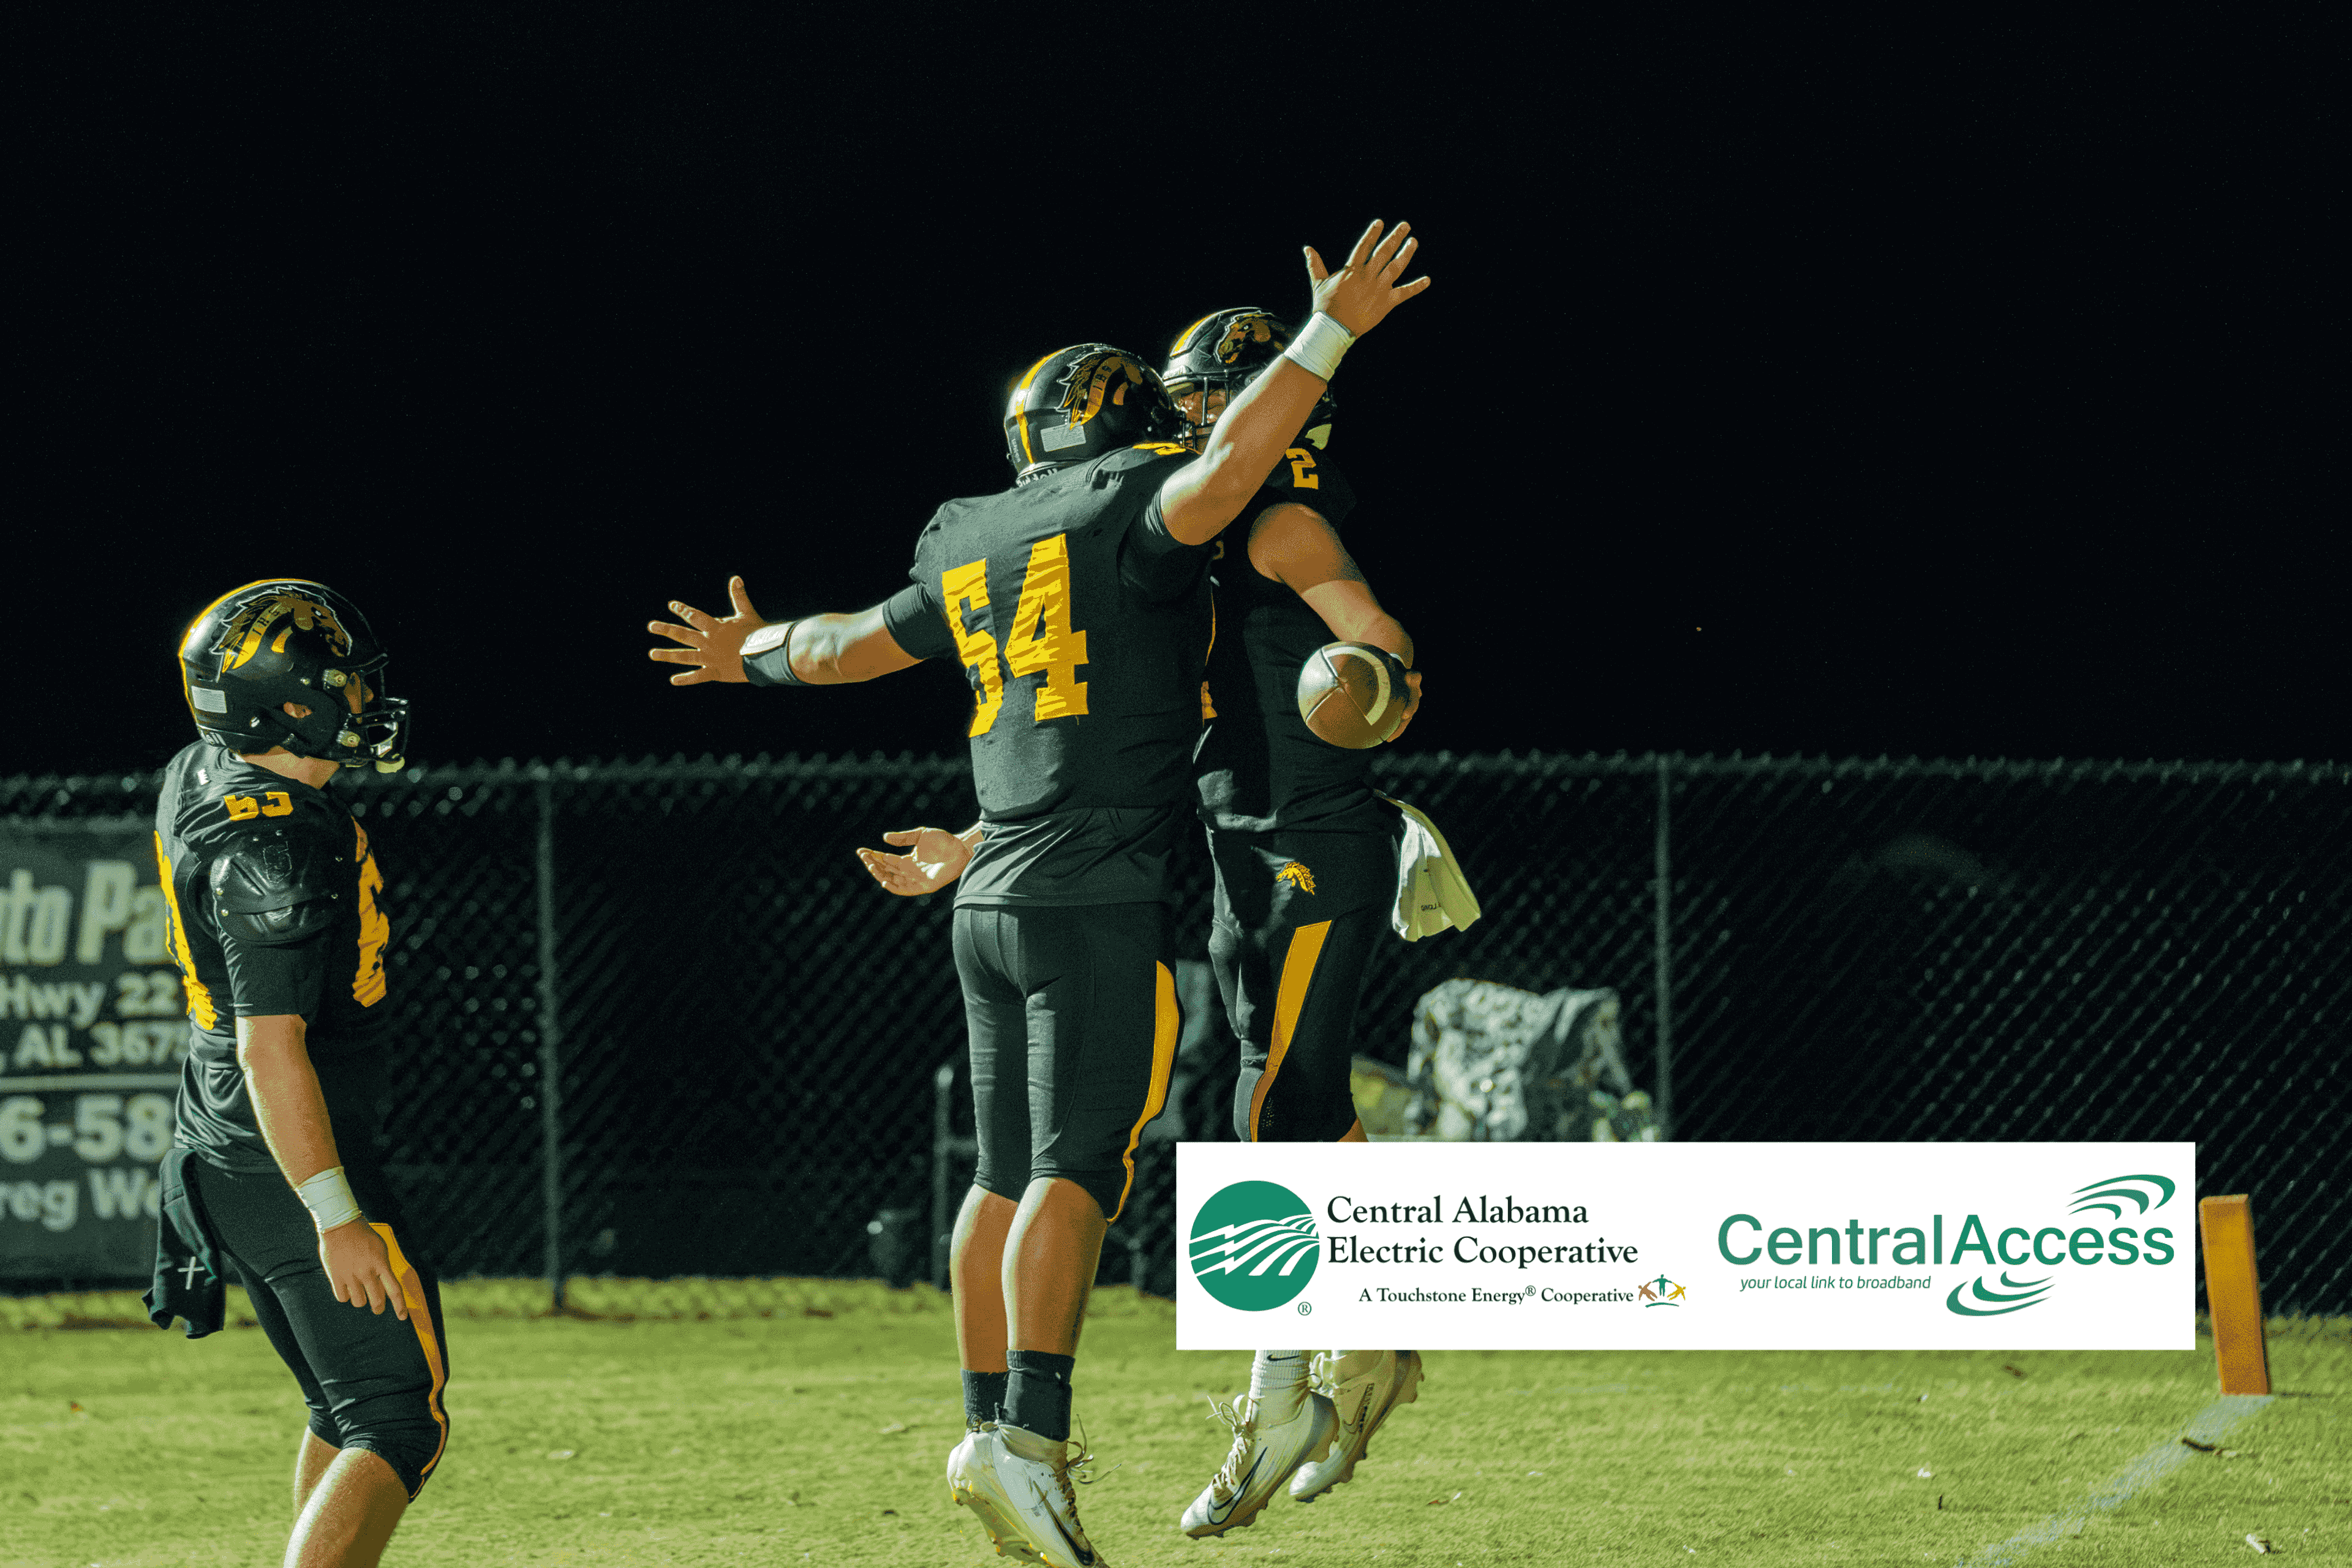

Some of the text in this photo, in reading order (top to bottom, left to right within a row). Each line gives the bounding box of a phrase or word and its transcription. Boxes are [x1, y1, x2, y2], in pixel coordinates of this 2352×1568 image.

[1286, 448, 1319, 489] 2
[941, 533, 1089, 738] 54
[0, 969, 180, 1030] Hwy 22
[12, 1022, 83, 1069] AL
